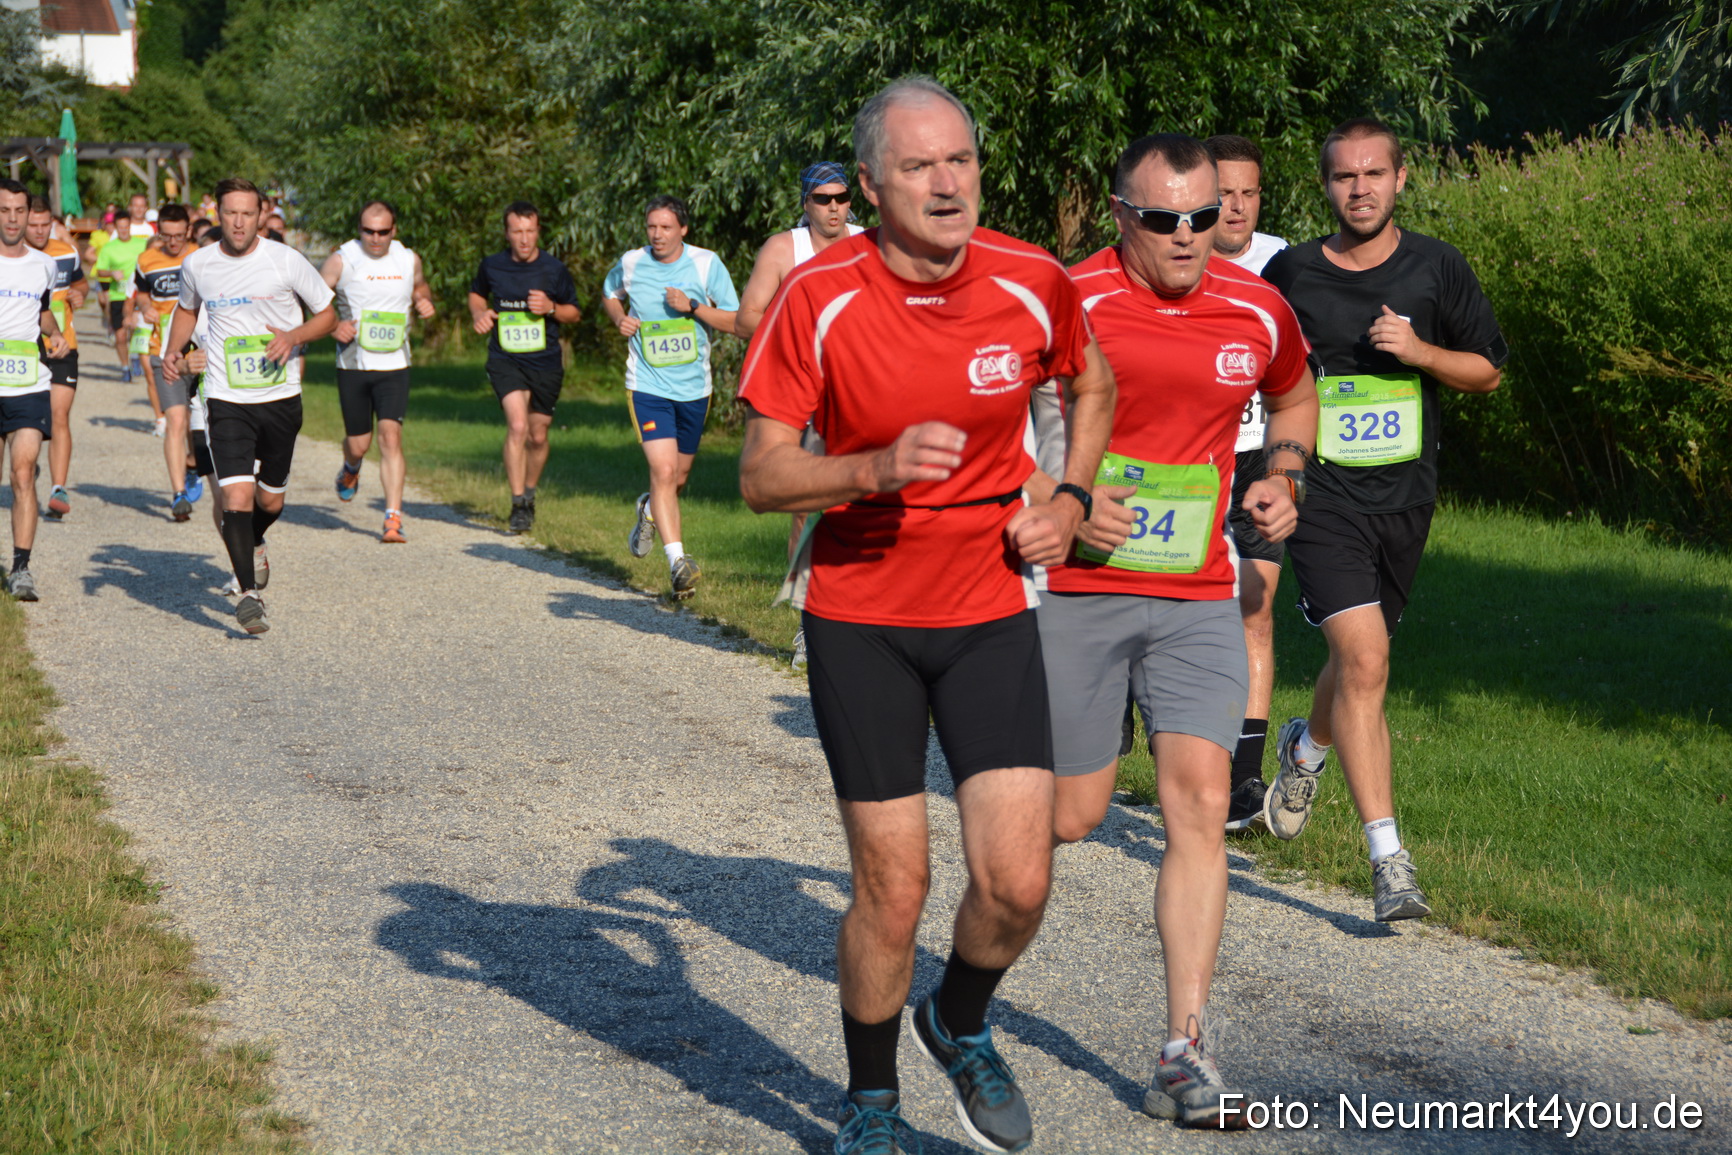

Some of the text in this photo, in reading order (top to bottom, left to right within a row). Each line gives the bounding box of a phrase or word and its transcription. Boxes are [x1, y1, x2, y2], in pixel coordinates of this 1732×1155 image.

[906, 297, 939, 306] CRAFT
[369, 326, 396, 341] 606
[504, 327, 540, 341] 1319
[648, 336, 692, 355] 1430
[1332, 389, 1369, 399] firmenlauf
[1338, 410, 1401, 442] 328
[1370, 444, 1403, 453] Sammüller
[1113, 474, 1160, 490] firmenlauf
[1129, 547, 1190, 560] Auhuber-Eggers
